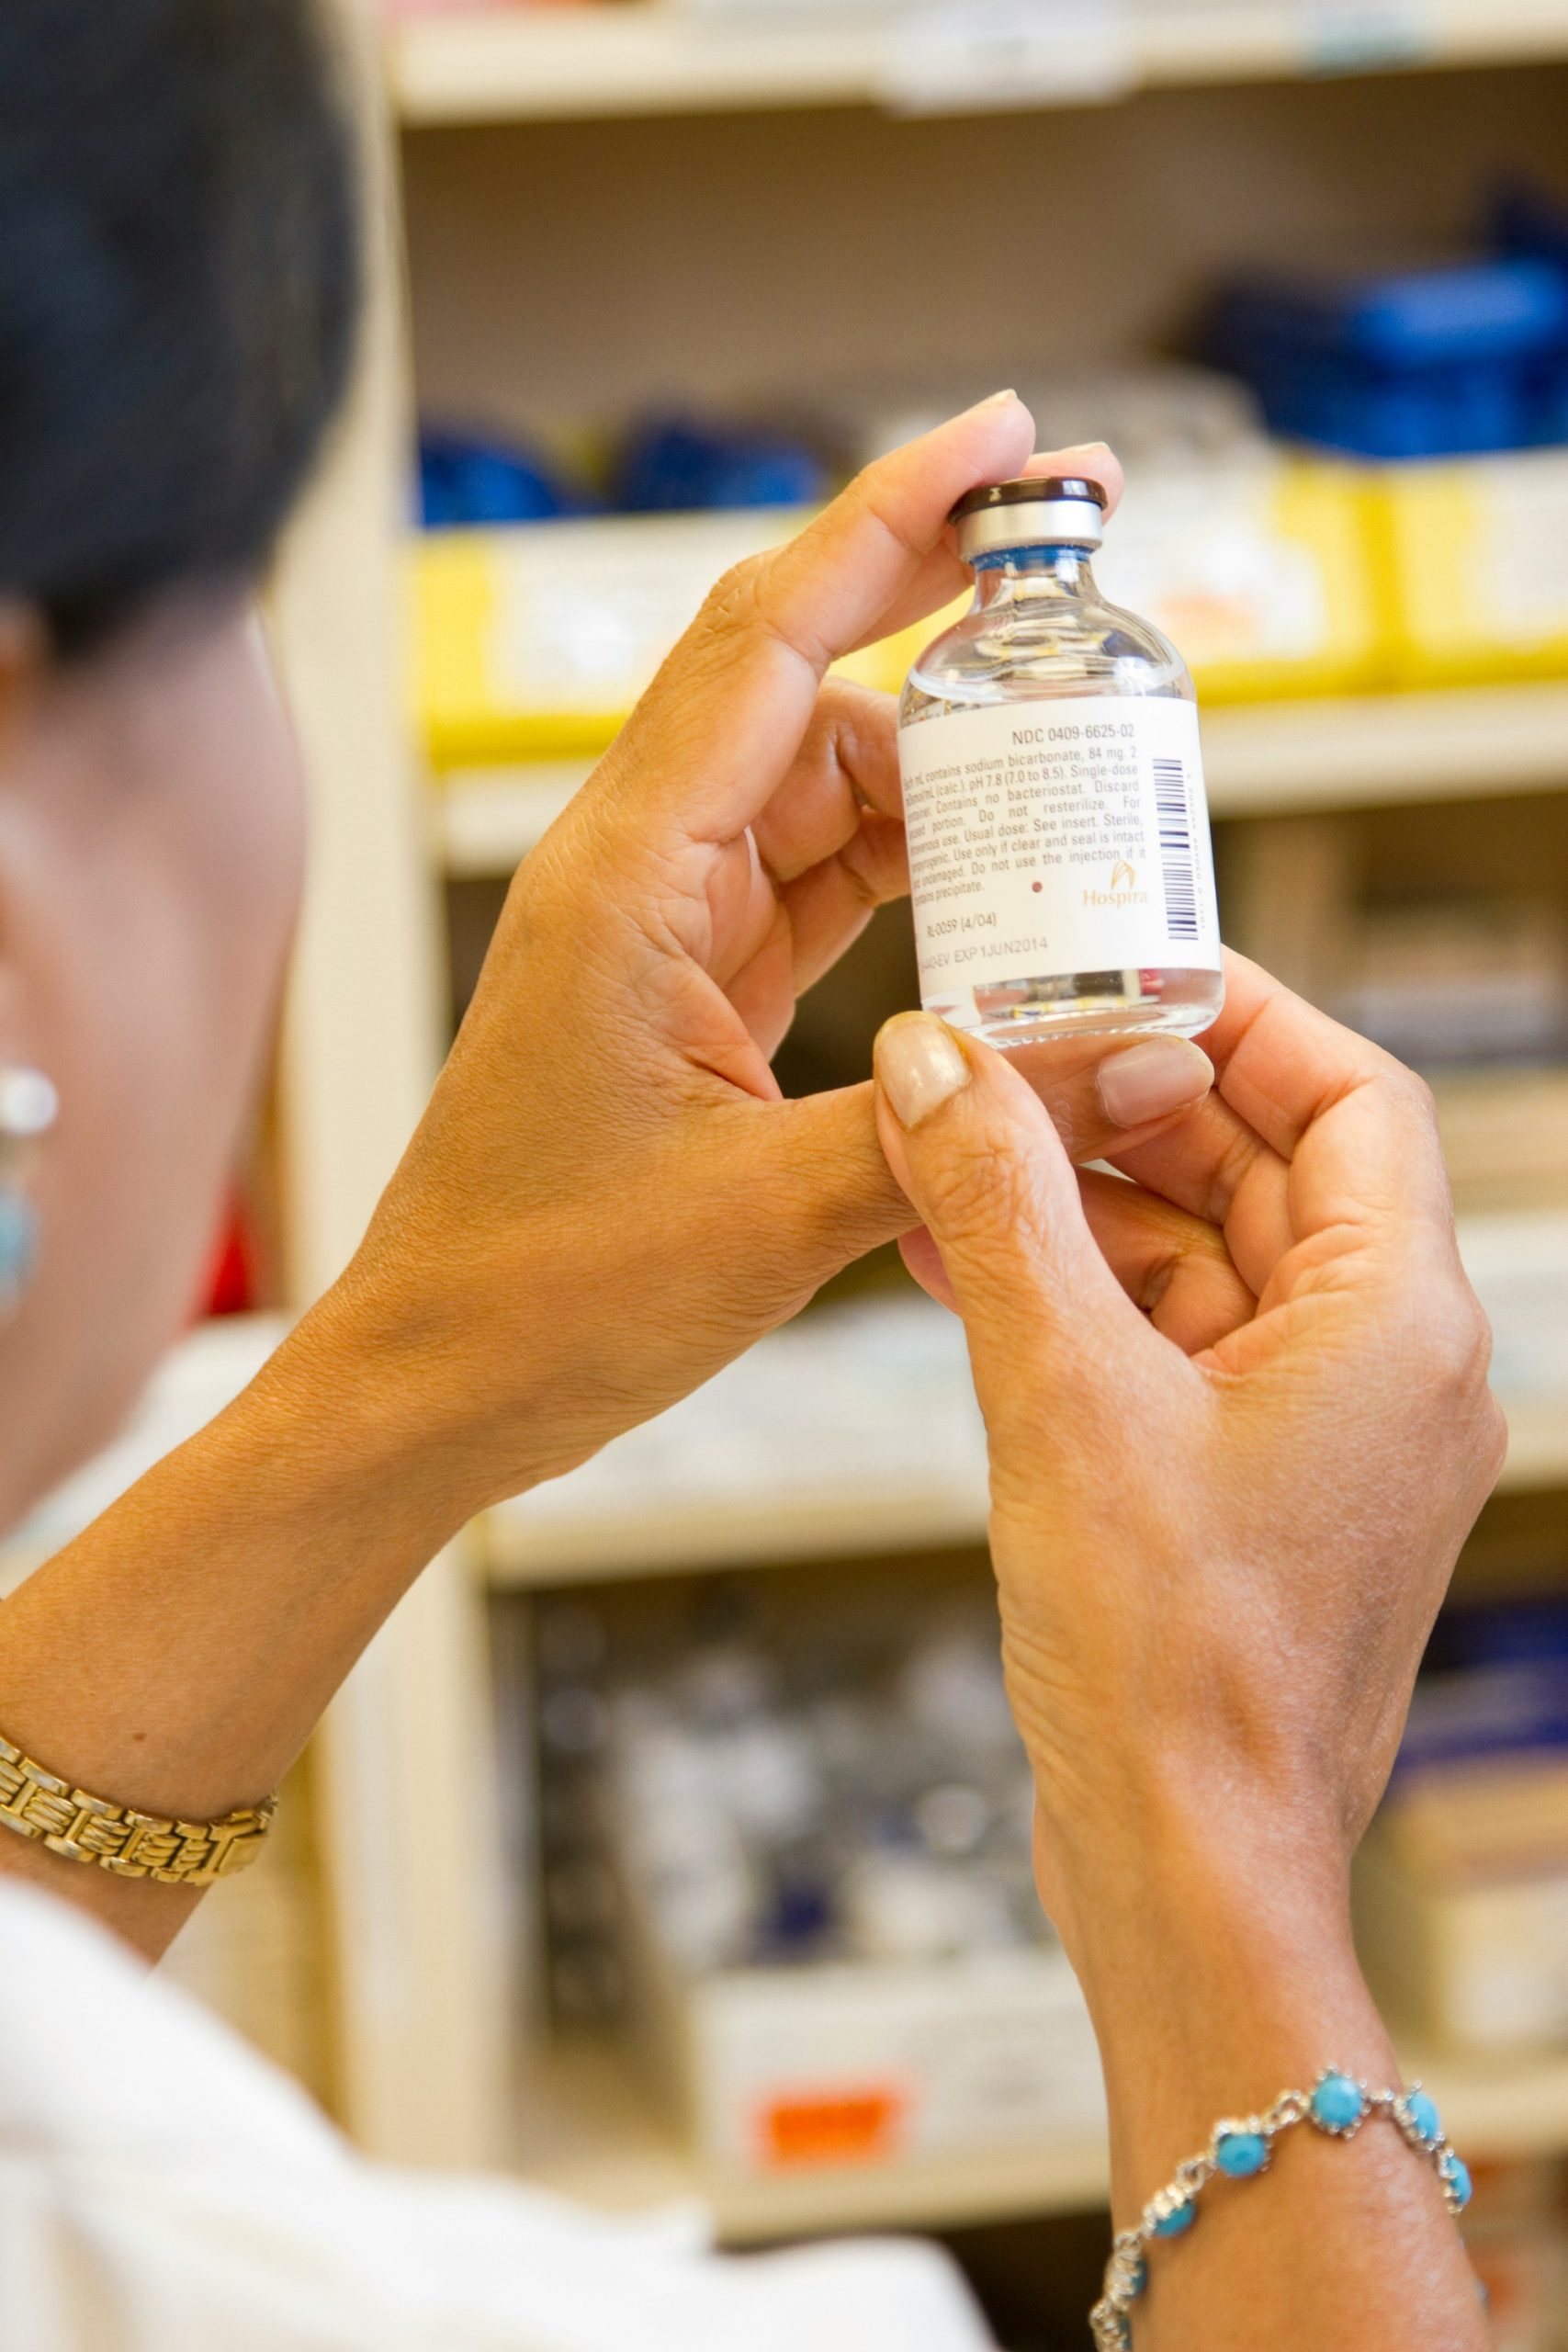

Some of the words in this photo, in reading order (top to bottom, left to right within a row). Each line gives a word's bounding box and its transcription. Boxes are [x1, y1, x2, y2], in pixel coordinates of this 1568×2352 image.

[1012, 729, 1044, 745] NDC
[1047, 723, 1134, 741] 0409-6625-02
[926, 764, 962, 782] contains
[964, 758, 1004, 774] sodium
[1008, 750, 1085, 767] bicarbonate,
[1089, 747, 1102, 759] 84
[1107, 748, 1126, 761] mg.
[1131, 745, 1137, 758] 2
[969, 775, 984, 792] pH
[985, 774, 1003, 787] 7.8
[1005, 770, 1026, 786] (7.0
[1028, 769, 1040, 781] to
[1070, 763, 1138, 779] Single-dose
[936, 796, 978, 814] Contains
[985, 793, 1000, 805] no
[1008, 783, 1087, 801] bacteriostat.
[1095, 779, 1140, 794] Discard
[978, 808, 995, 823] Do
[1009, 805, 1028, 819] not
[1043, 798, 1109, 814] resterilize.
[1123, 796, 1141, 809] For
[964, 825, 994, 842] Usual
[998, 823, 1029, 837] dose:
[1033, 818, 1057, 832] See
[1062, 816, 1098, 829] insert.
[1104, 813, 1144, 827] Sterile,
[953, 848, 973, 862] Use
[975, 842, 998, 858] only
[1000, 840, 1009, 854] if
[1011, 837, 1041, 853] clear
[1045, 834, 1067, 848] and
[1071, 832, 1097, 845] seal
[1100, 831, 1110, 843] is
[1113, 831, 1145, 843] intact
[971, 861, 986, 875] Do
[991, 859, 1010, 872] not
[1015, 855, 1037, 868] use
[1043, 852, 1063, 865] the
[1069, 848, 1121, 865] injection
[1126, 846, 1134, 859] if
[1139, 846, 1146, 859] it
[1083, 889, 1148, 909] Hospira
[960, 911, 998, 933] (4/04)
[954, 946, 978, 964] EXP
[981, 937, 1048, 958] 1JUN2014
